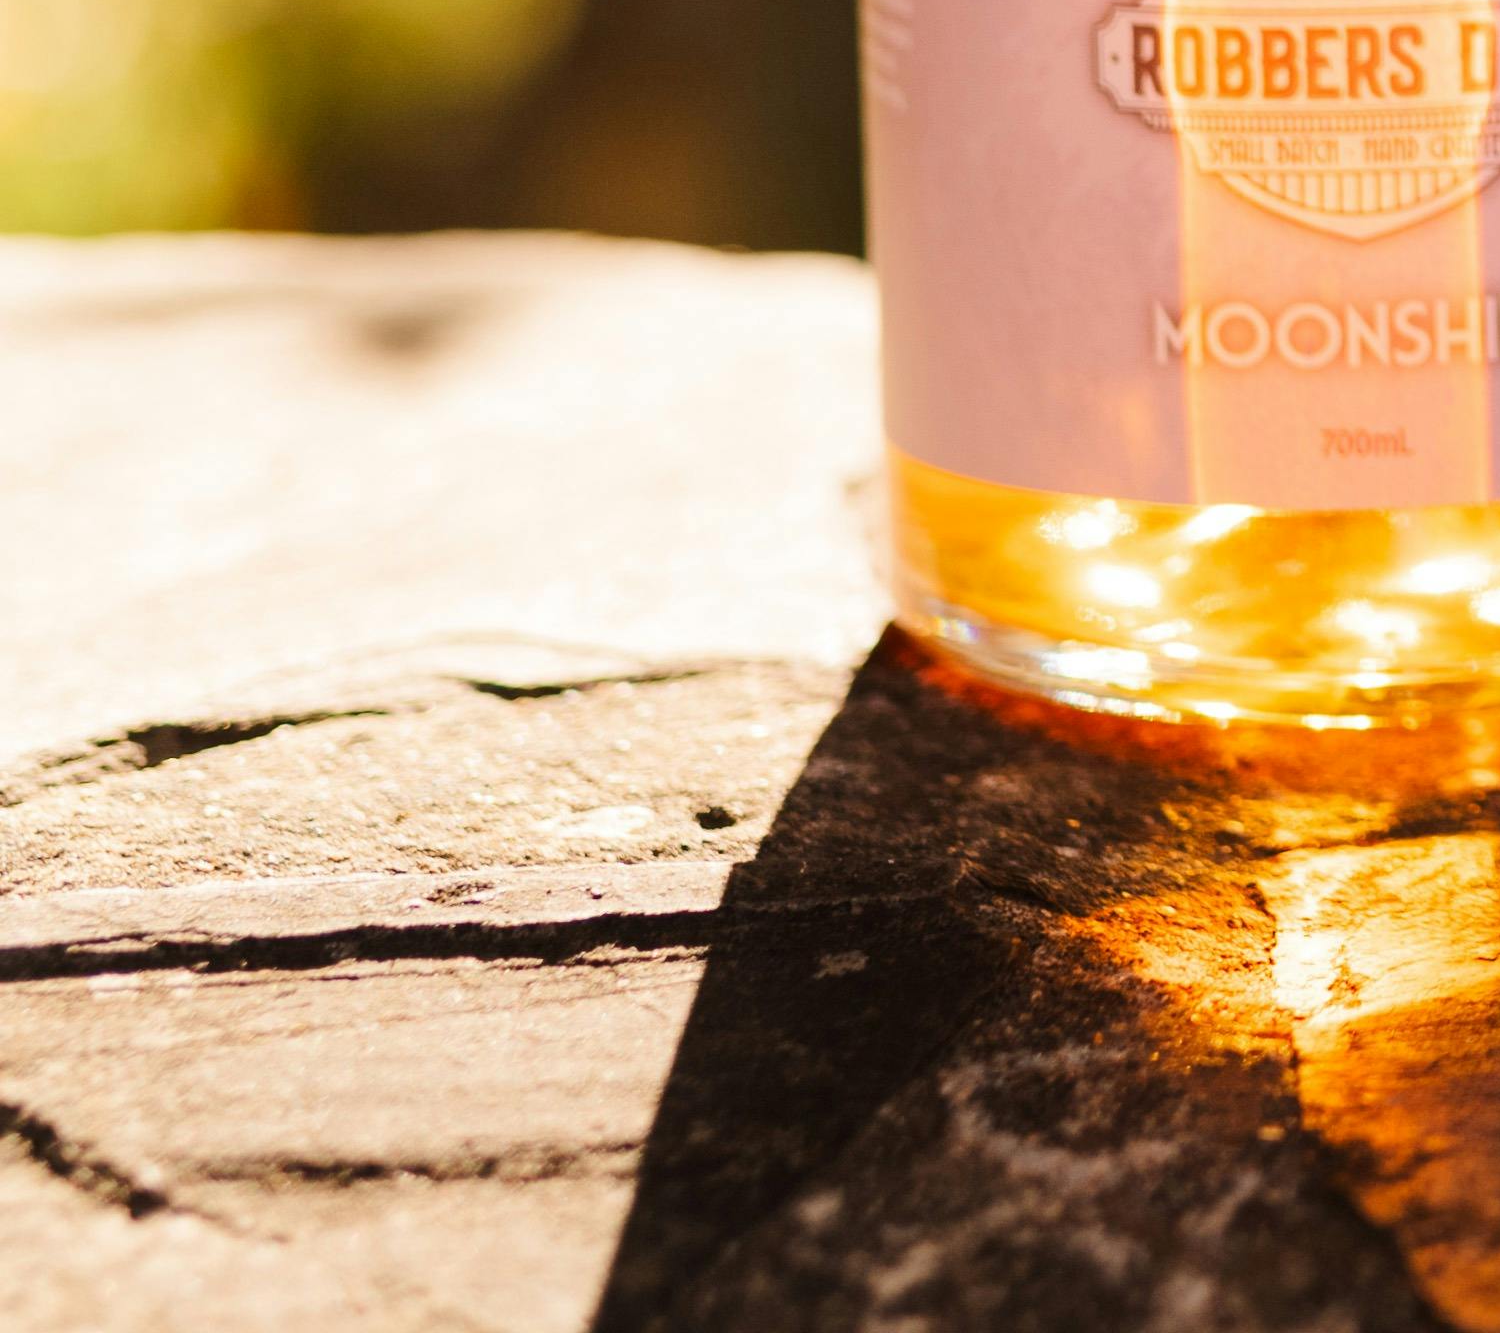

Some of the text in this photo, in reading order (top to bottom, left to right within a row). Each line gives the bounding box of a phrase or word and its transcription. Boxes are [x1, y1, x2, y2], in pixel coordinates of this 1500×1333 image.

[1131, 23, 1426, 100] ROBBERS
[1209, 137, 1264, 165] SMALL
[1277, 137, 1341, 165] BATCH
[1364, 134, 1419, 162] HAND
[1319, 427, 1414, 459] 700mL
